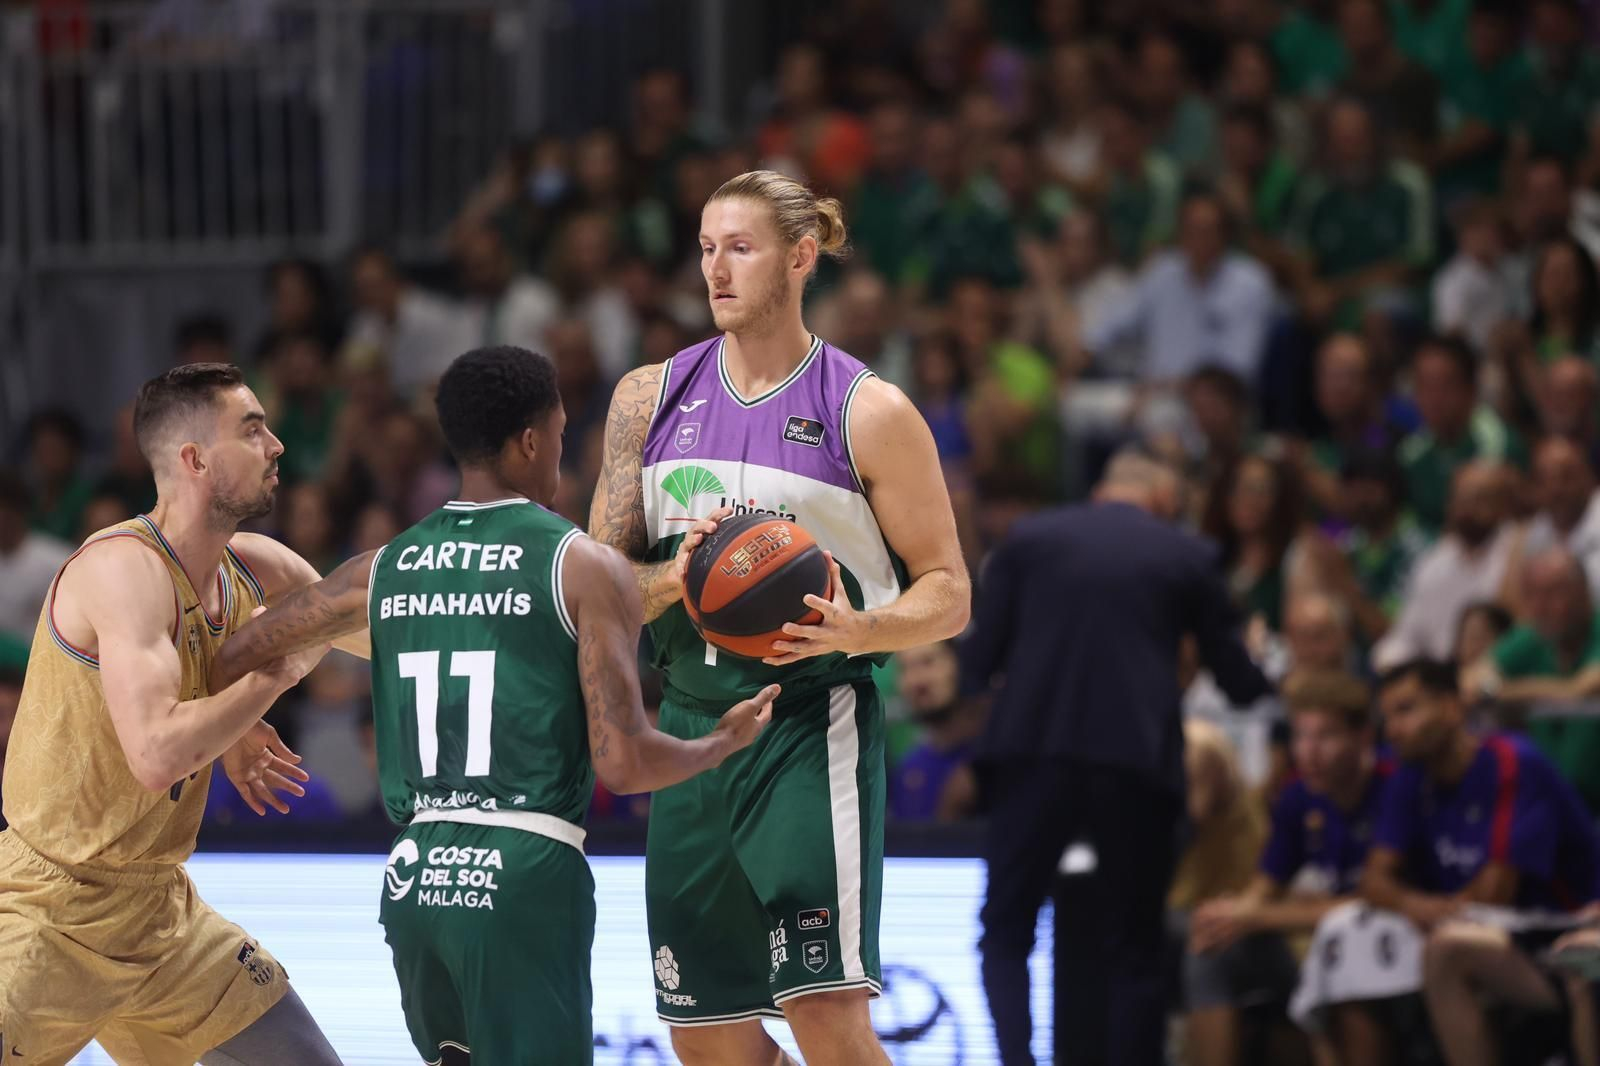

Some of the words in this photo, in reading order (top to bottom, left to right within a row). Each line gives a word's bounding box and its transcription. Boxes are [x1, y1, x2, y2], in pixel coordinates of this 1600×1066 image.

[787, 431, 819, 443] endesa
[789, 423, 804, 433] liga
[396, 541, 524, 571] CARTER
[380, 588, 532, 620] BENAHAVÍS
[398, 651, 496, 778] 11
[428, 846, 503, 870] COSTA
[420, 868, 453, 886] DEL
[456, 868, 498, 890] SOL
[418, 889, 494, 910] MALAGA
[801, 916, 823, 927] acb
